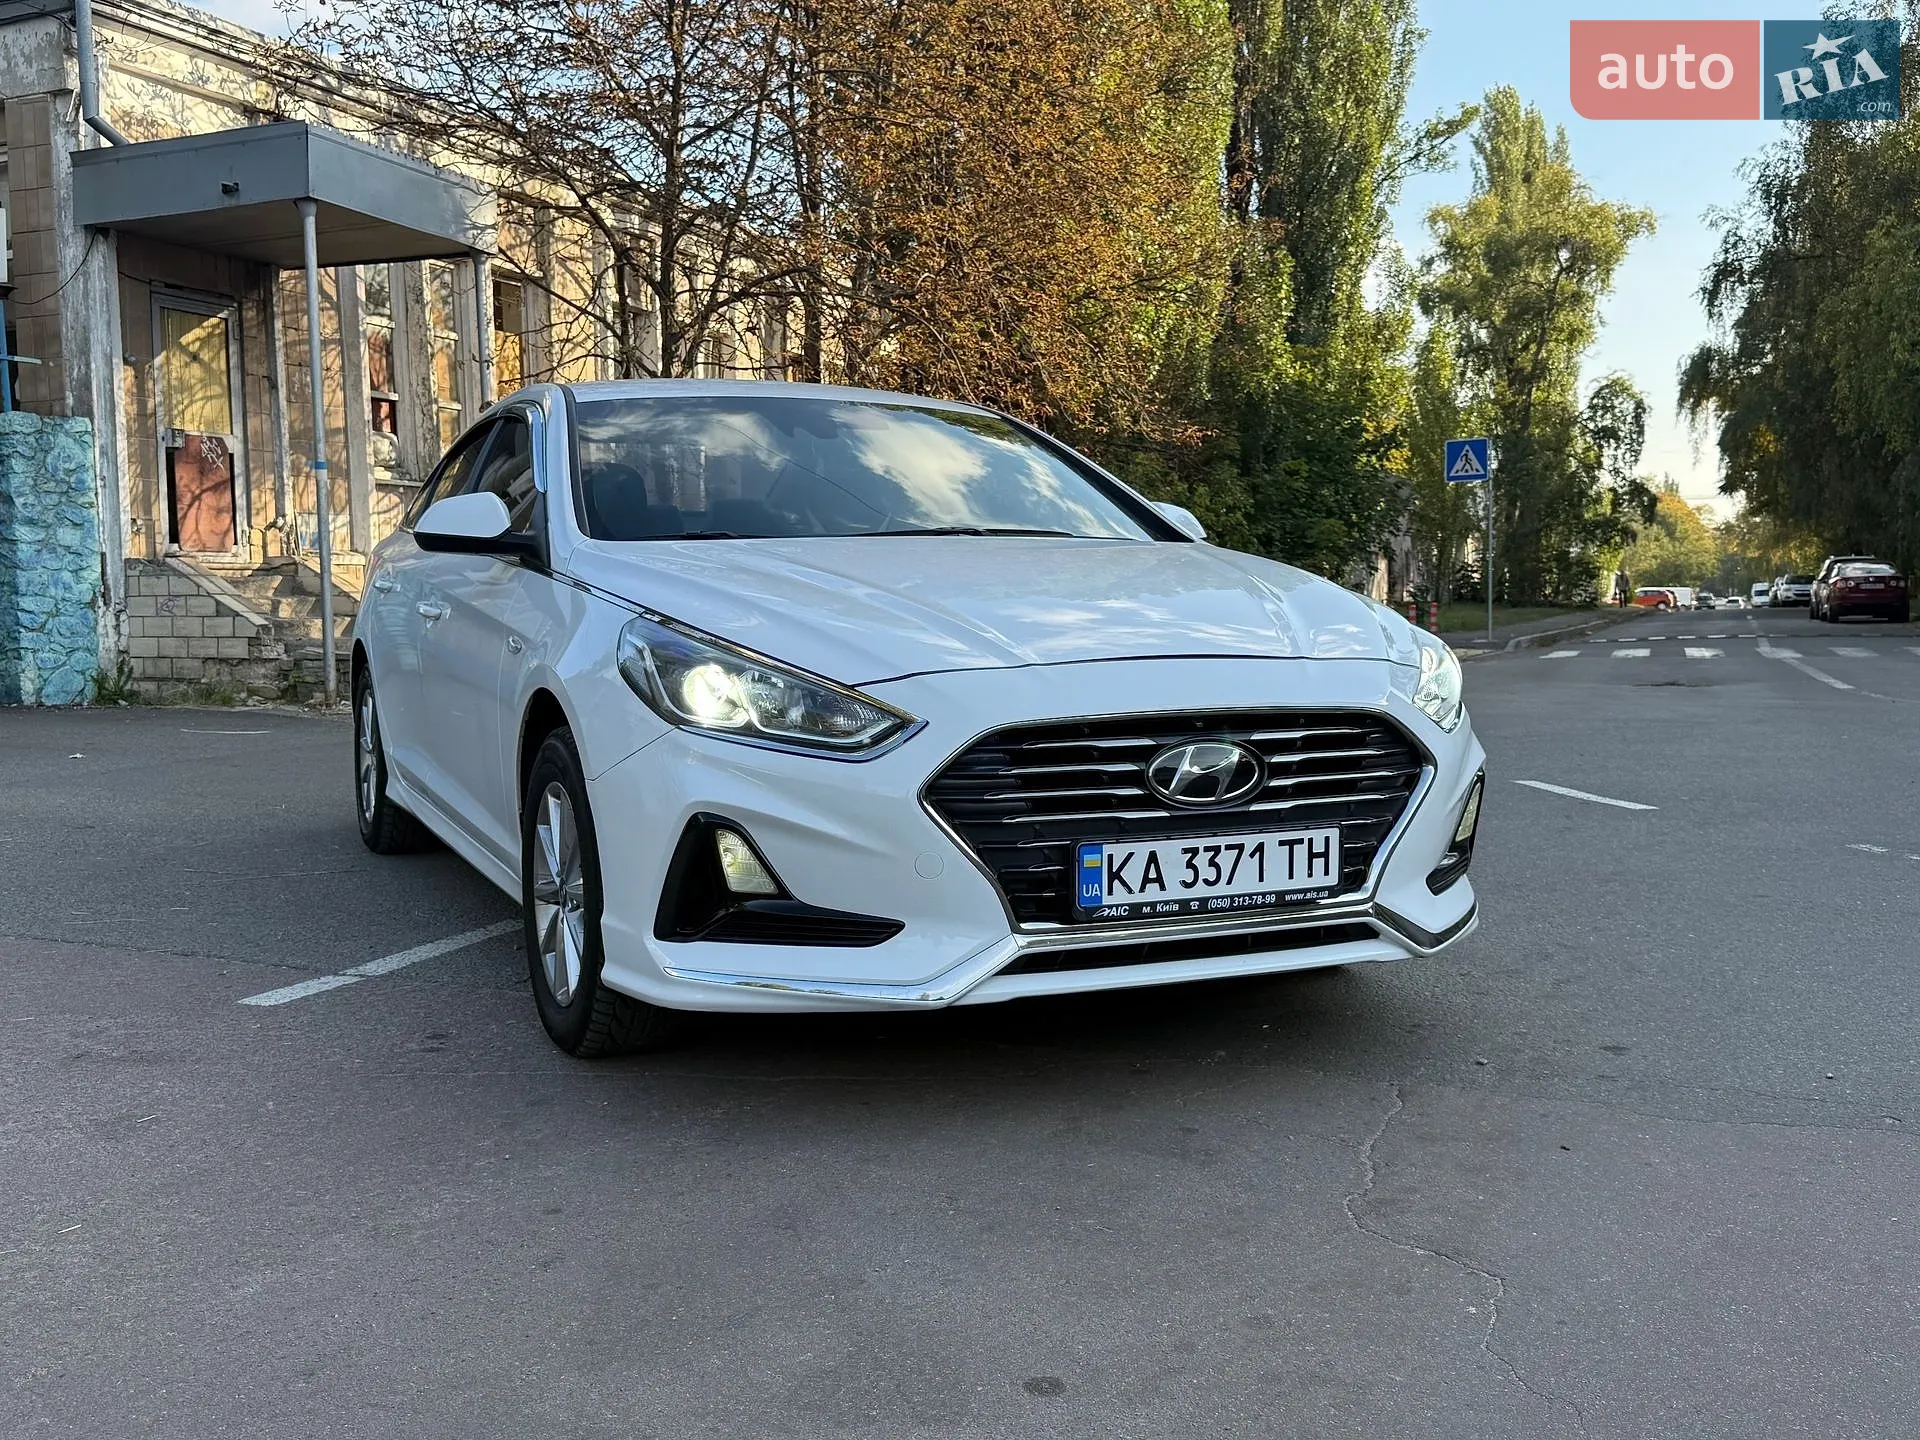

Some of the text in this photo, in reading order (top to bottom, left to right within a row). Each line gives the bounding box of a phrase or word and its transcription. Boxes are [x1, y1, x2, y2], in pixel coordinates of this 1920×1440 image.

[1106, 835, 1331, 897] KA 3371 TH
[1082, 883, 1101, 897] UA
[1156, 901, 1180, 913] Київ
[1207, 898, 1231, 910] (050)
[1232, 893, 1276, 907] 313-78-99
[1284, 890, 1329, 902] www.ais.ua
